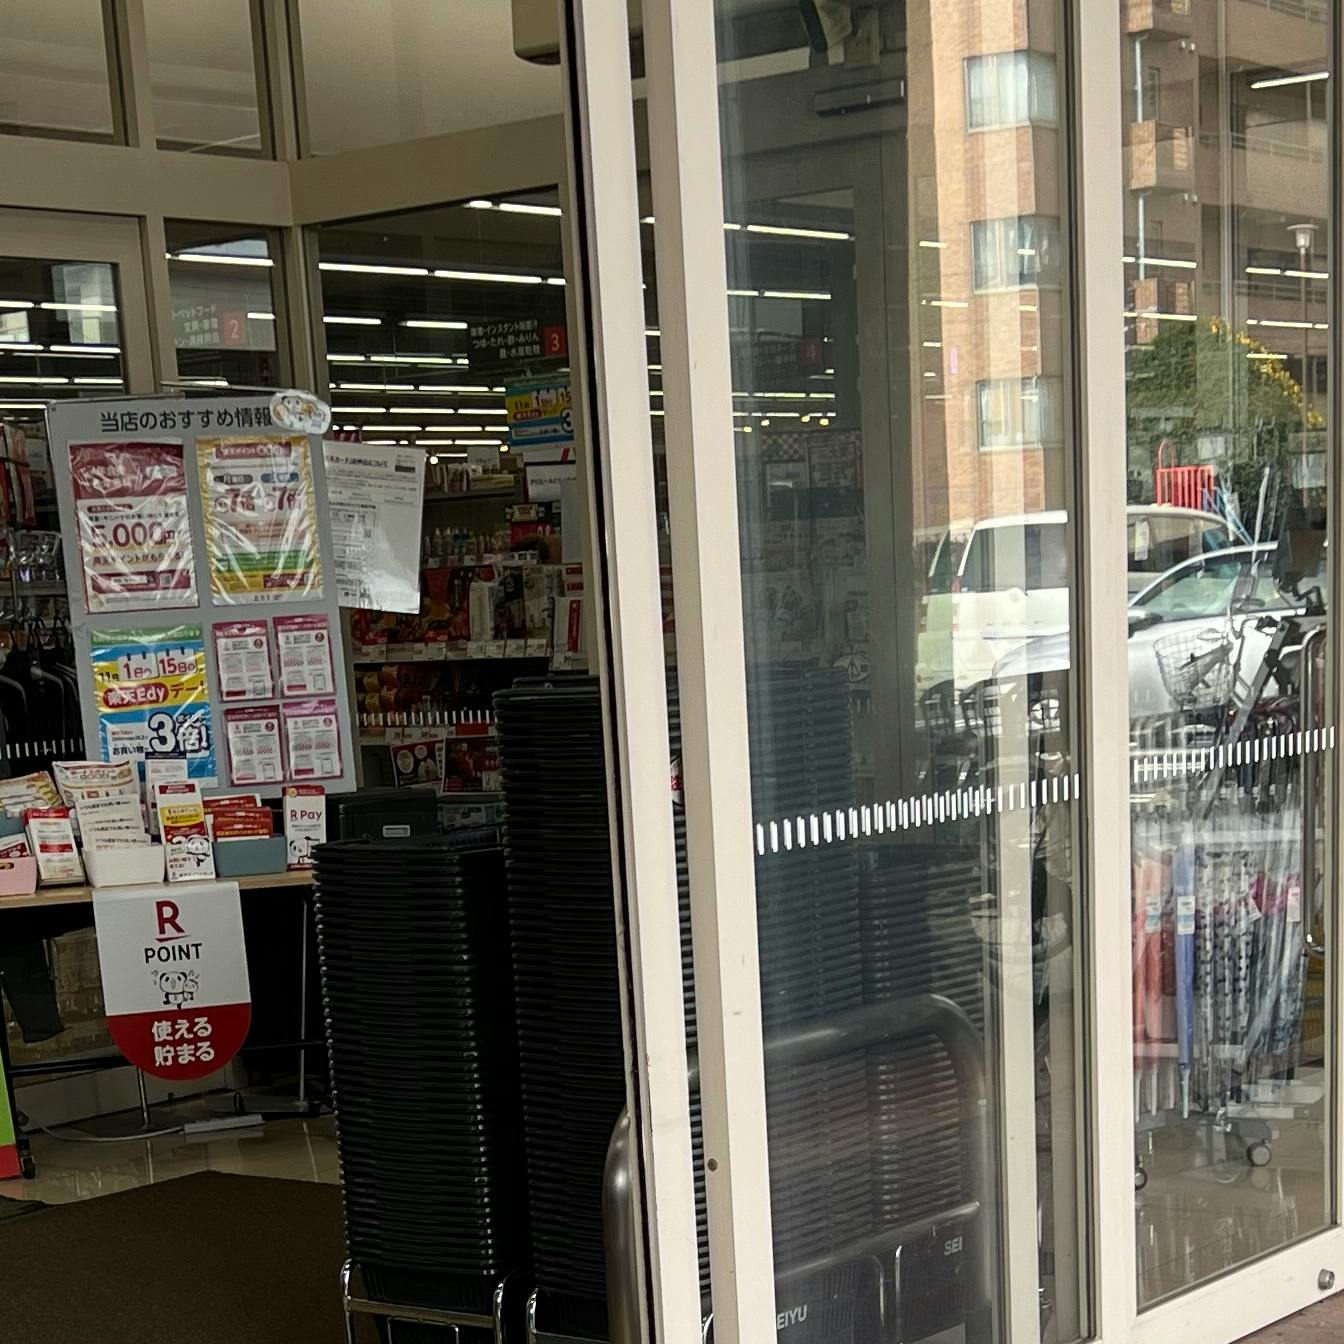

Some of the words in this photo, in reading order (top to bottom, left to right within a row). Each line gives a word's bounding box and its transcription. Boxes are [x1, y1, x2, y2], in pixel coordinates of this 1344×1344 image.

[230, 319, 240, 340] 2
[551, 333, 560, 352] 3
[100, 405, 272, 433] 当店のおすすめ情報
[301, 809, 323, 823] Pay
[155, 900, 185, 935] R
[144, 943, 203, 964] POINT
[151, 1017, 213, 1042] 使える
[153, 1042, 216, 1067] 貯まる
